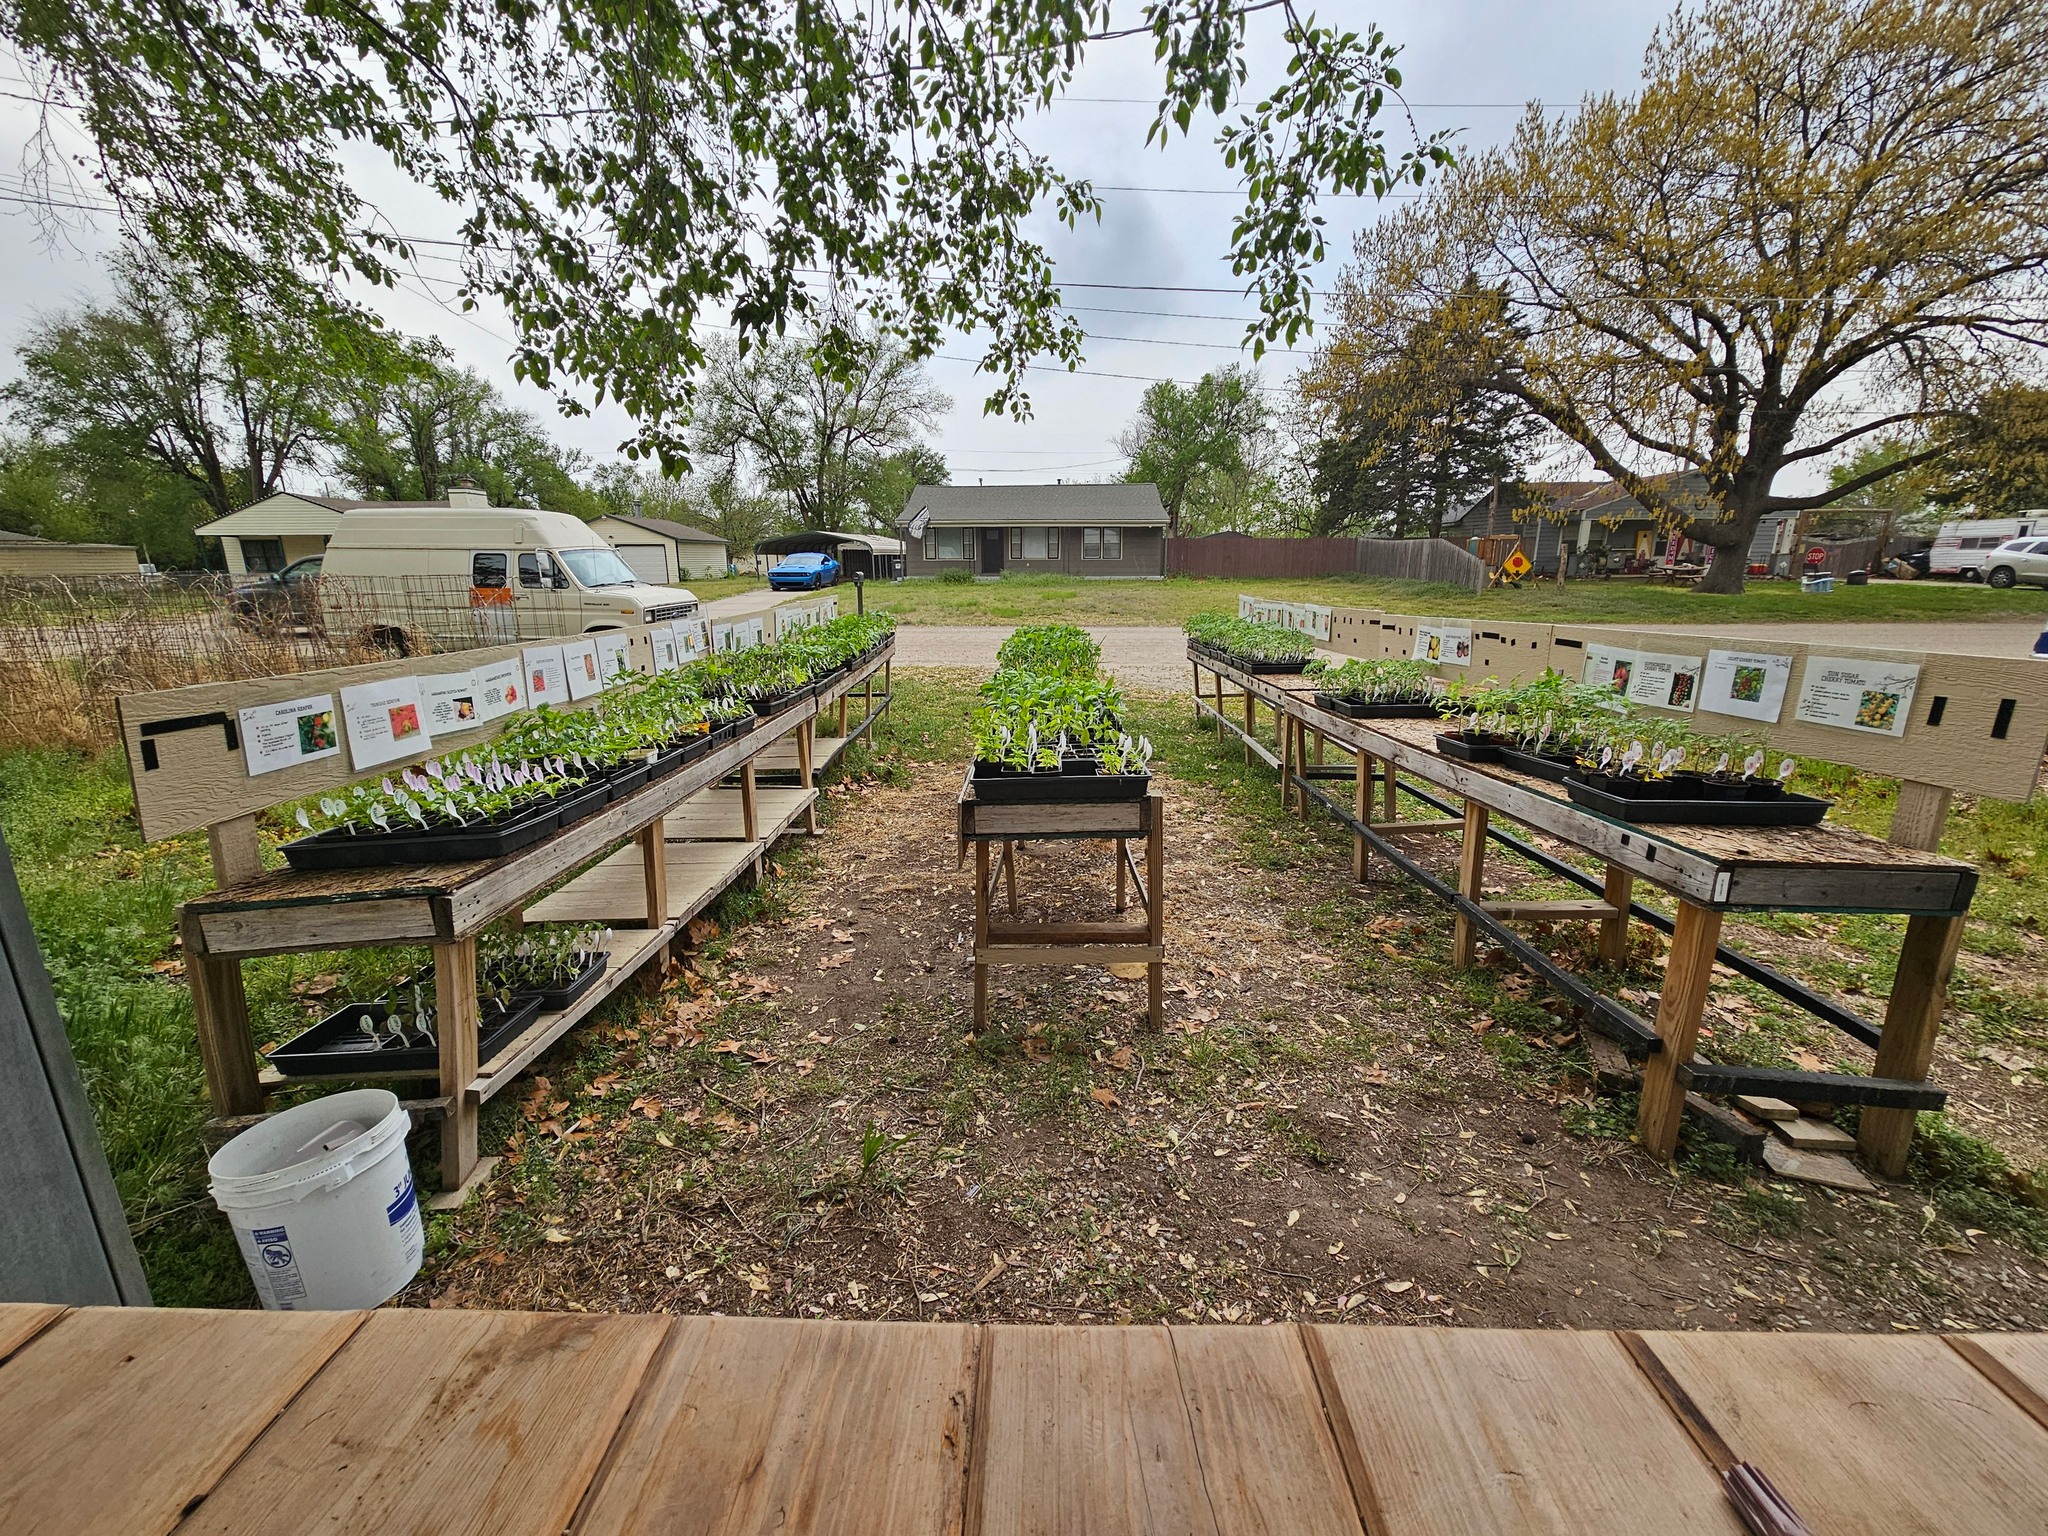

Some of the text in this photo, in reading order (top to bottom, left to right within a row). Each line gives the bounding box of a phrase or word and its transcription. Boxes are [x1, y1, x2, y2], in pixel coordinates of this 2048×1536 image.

[1807, 552, 1824, 560] STOP
[1841, 671, 1859, 679] SUGAR
[1821, 675, 1866, 686] CHERRY TOMATO
[275, 704, 313, 716] CAROLINA REAPER
[259, 1228, 284, 1236] WARNING
